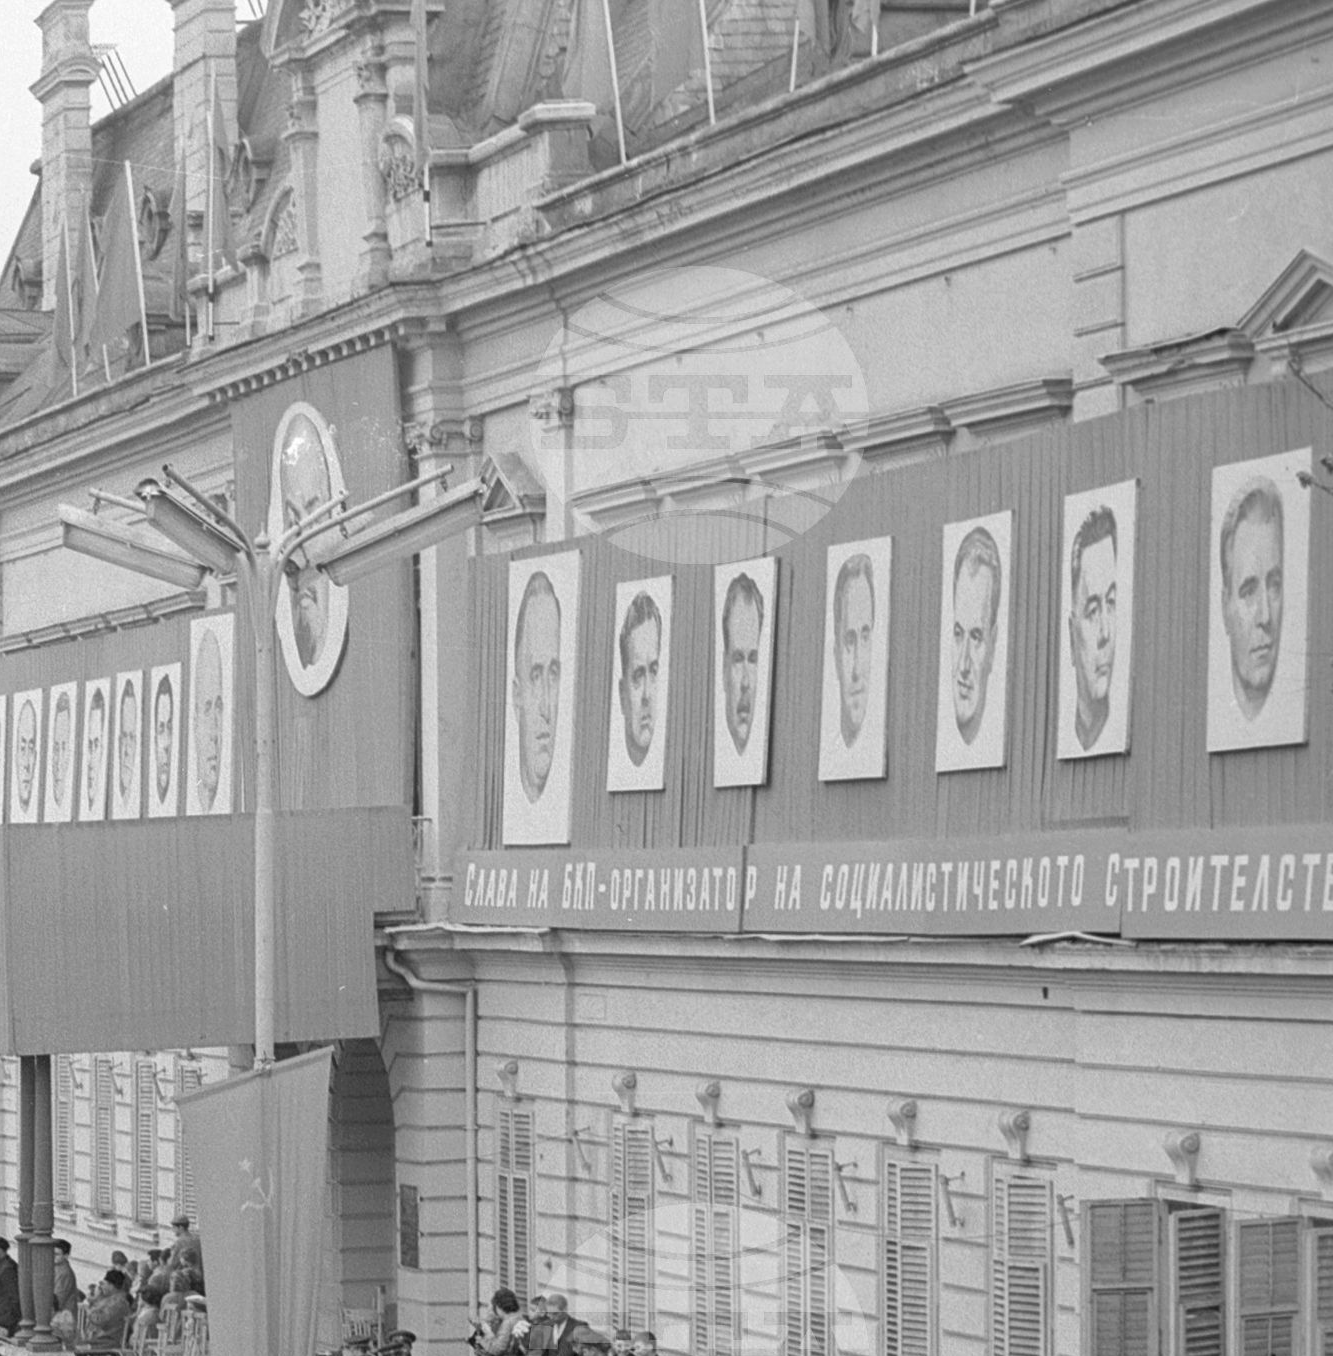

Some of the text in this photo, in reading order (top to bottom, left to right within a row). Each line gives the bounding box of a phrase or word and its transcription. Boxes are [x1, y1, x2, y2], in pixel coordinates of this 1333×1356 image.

[464, 862, 518, 907] СЛАВА
[527, 867, 549, 909] НА
[774, 864, 802, 910] НА
[819, 854, 1084, 919] СОЦИАЛИСТИЧЕСКОТО
